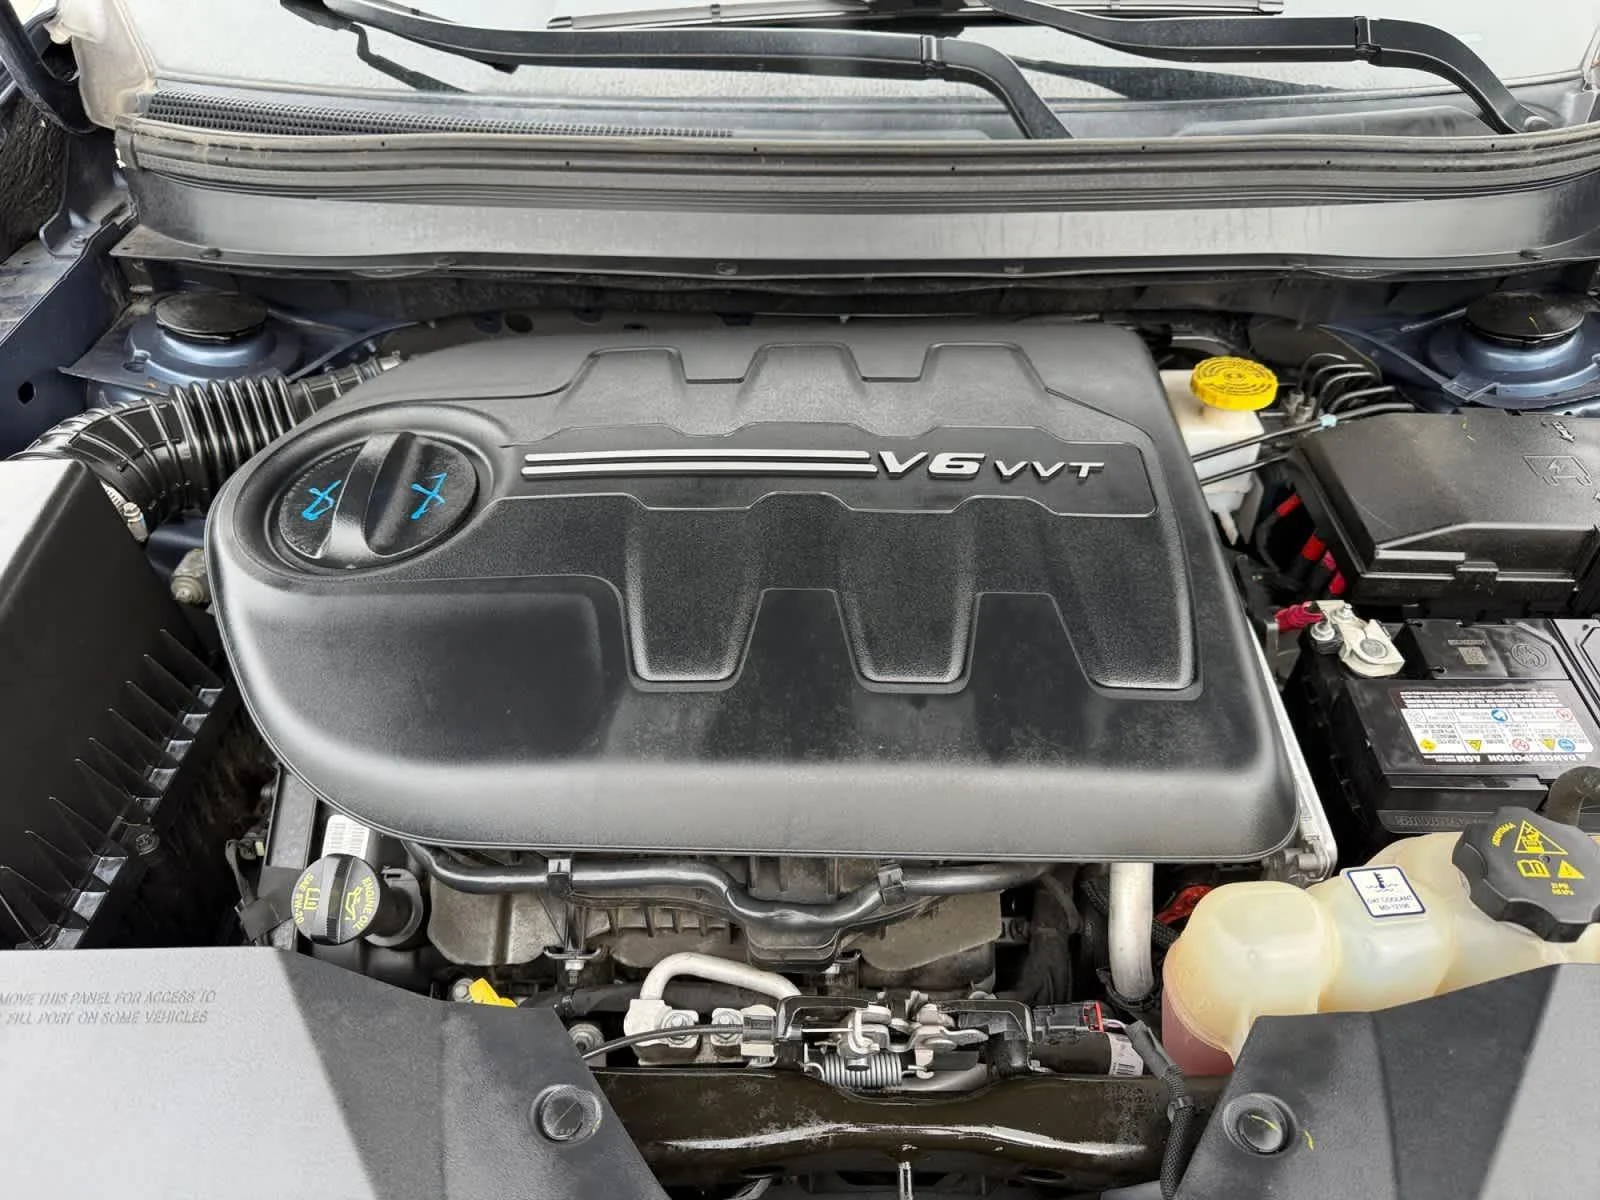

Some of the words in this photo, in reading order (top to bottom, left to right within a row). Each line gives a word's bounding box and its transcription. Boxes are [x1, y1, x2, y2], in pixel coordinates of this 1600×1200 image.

[879, 451, 985, 478] V6
[994, 459, 1105, 480] VVT
[361, 876, 376, 914] ENGINE
[352, 914, 369, 930] OIL
[39, 992, 67, 1005] THIS
[70, 991, 111, 1005] PANEL
[114, 991, 142, 1005] FOR
[143, 991, 194, 1004] ACCESS
[199, 990, 216, 1003] TO
[37, 1011, 73, 1025] PORT
[77, 1011, 98, 1024] ON
[102, 1011, 140, 1024] SOME
[144, 1010, 209, 1024] VEHICLES
